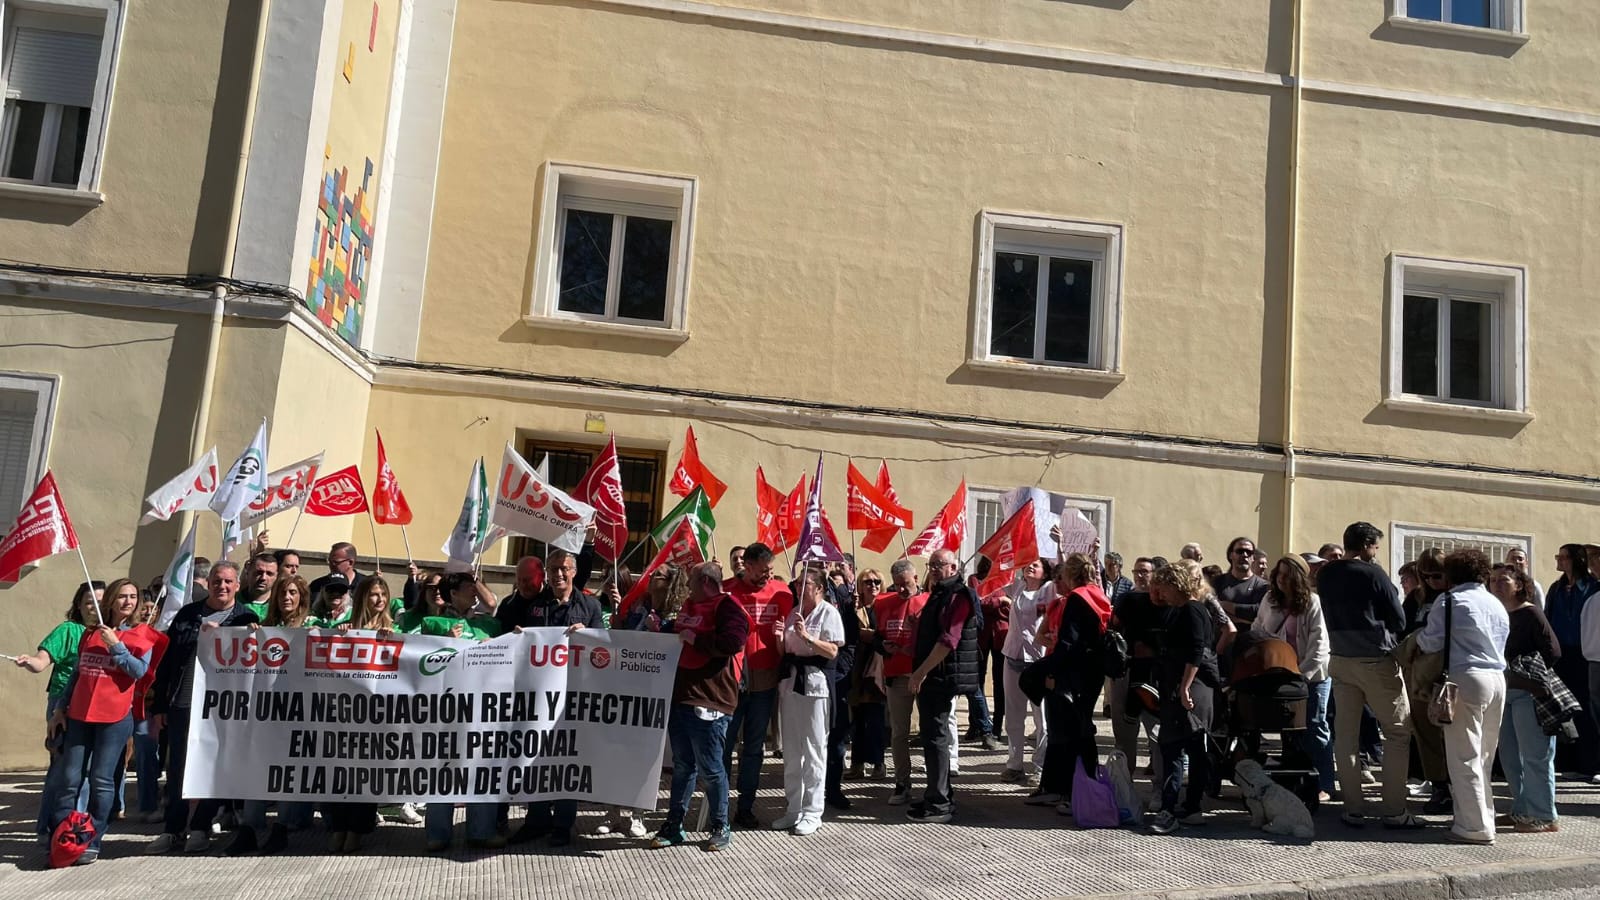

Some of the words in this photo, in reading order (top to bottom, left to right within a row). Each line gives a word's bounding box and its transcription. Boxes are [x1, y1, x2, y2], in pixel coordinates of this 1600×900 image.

[517, 503, 548, 521] SINDICAL
[550, 518, 578, 533] OBRERA
[215, 637, 290, 667] USO
[311, 641, 397, 665] CCOO
[530, 644, 586, 667] UGT
[621, 649, 667, 661] Servicios
[304, 671, 335, 679] servicios
[343, 671, 350, 679] la
[621, 662, 661, 673] Públicos
[202, 690, 249, 721] POR
[255, 691, 304, 722] UNA
[310, 687, 474, 724] NEGOCIACIÓN
[481, 691, 538, 723] REAL
[545, 691, 561, 721] Y
[565, 691, 666, 729] EFECTIVA
[289, 730, 318, 758] EN
[322, 731, 416, 760] DEFENSA
[421, 732, 460, 760] DEL
[466, 729, 579, 759] PERSONAL
[267, 765, 296, 794] DE
[300, 765, 326, 794] LA
[332, 763, 469, 796] DIPUTACIÓN
[474, 766, 502, 795] DE
[506, 765, 593, 794] CUENCA
